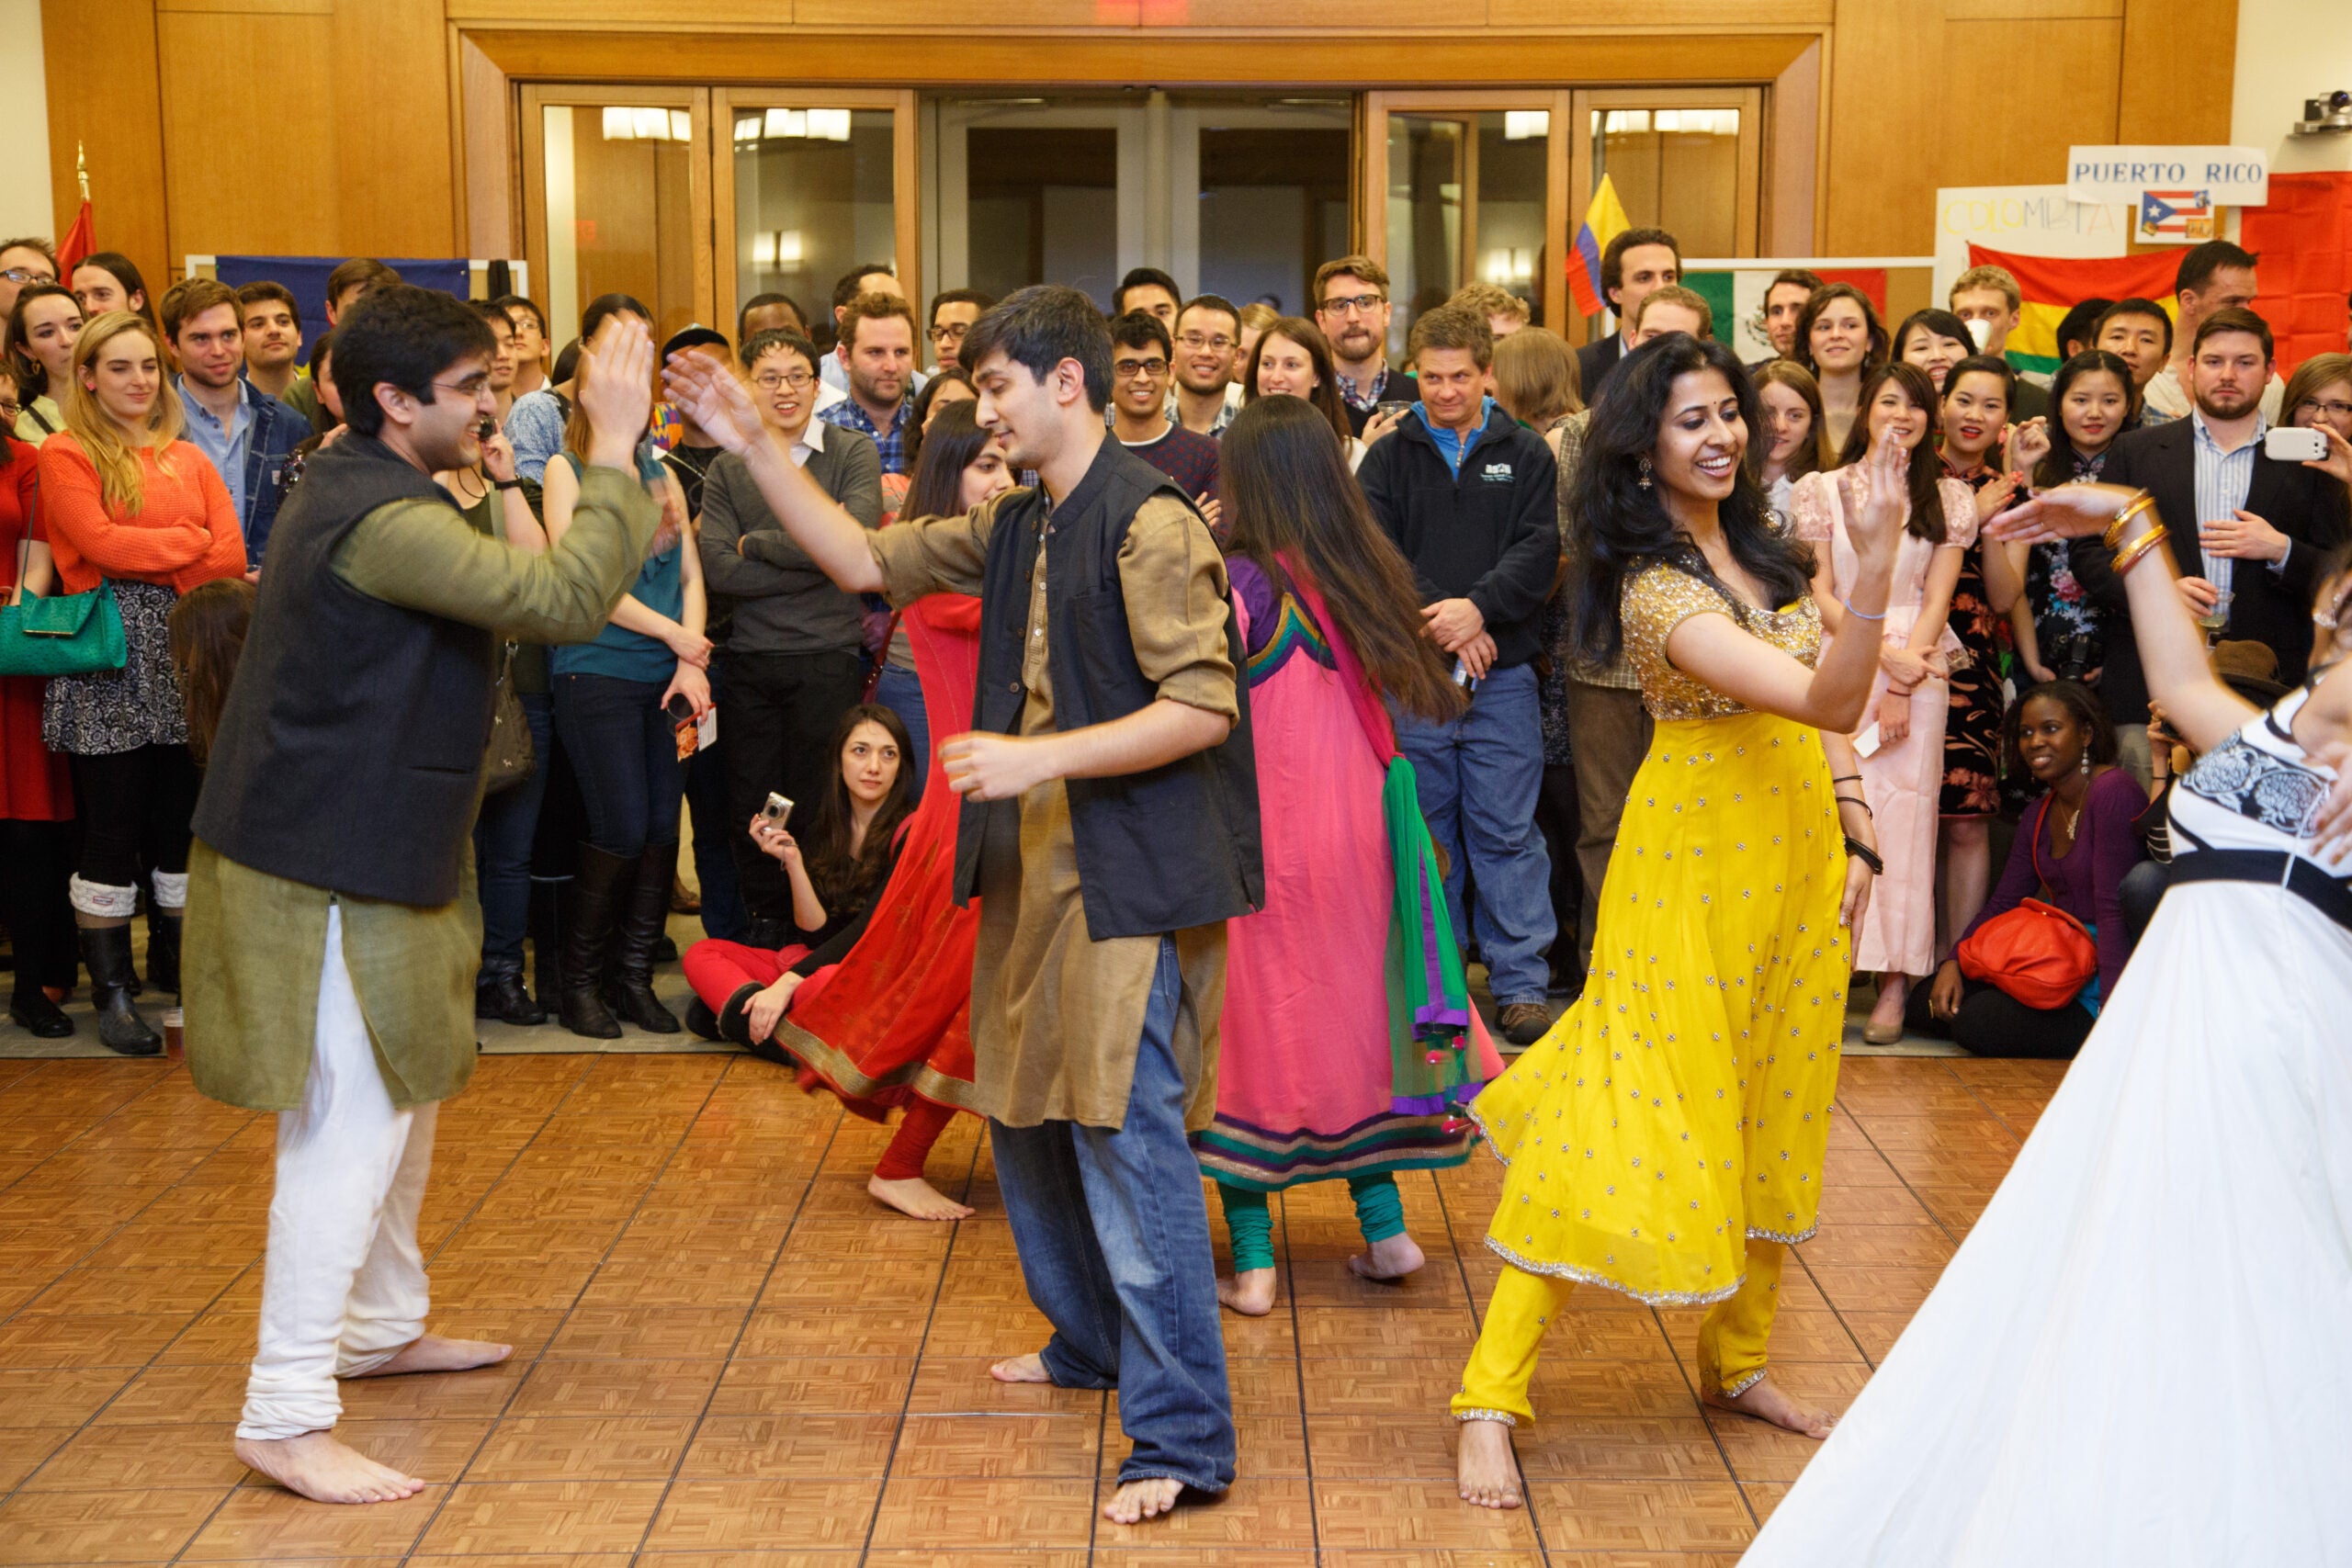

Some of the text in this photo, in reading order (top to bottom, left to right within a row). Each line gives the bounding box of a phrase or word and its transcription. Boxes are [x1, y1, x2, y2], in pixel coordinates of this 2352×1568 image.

[2075, 163, 2262, 183] PUERTO RICO
[1943, 197, 2115, 235] COLOMBIA
